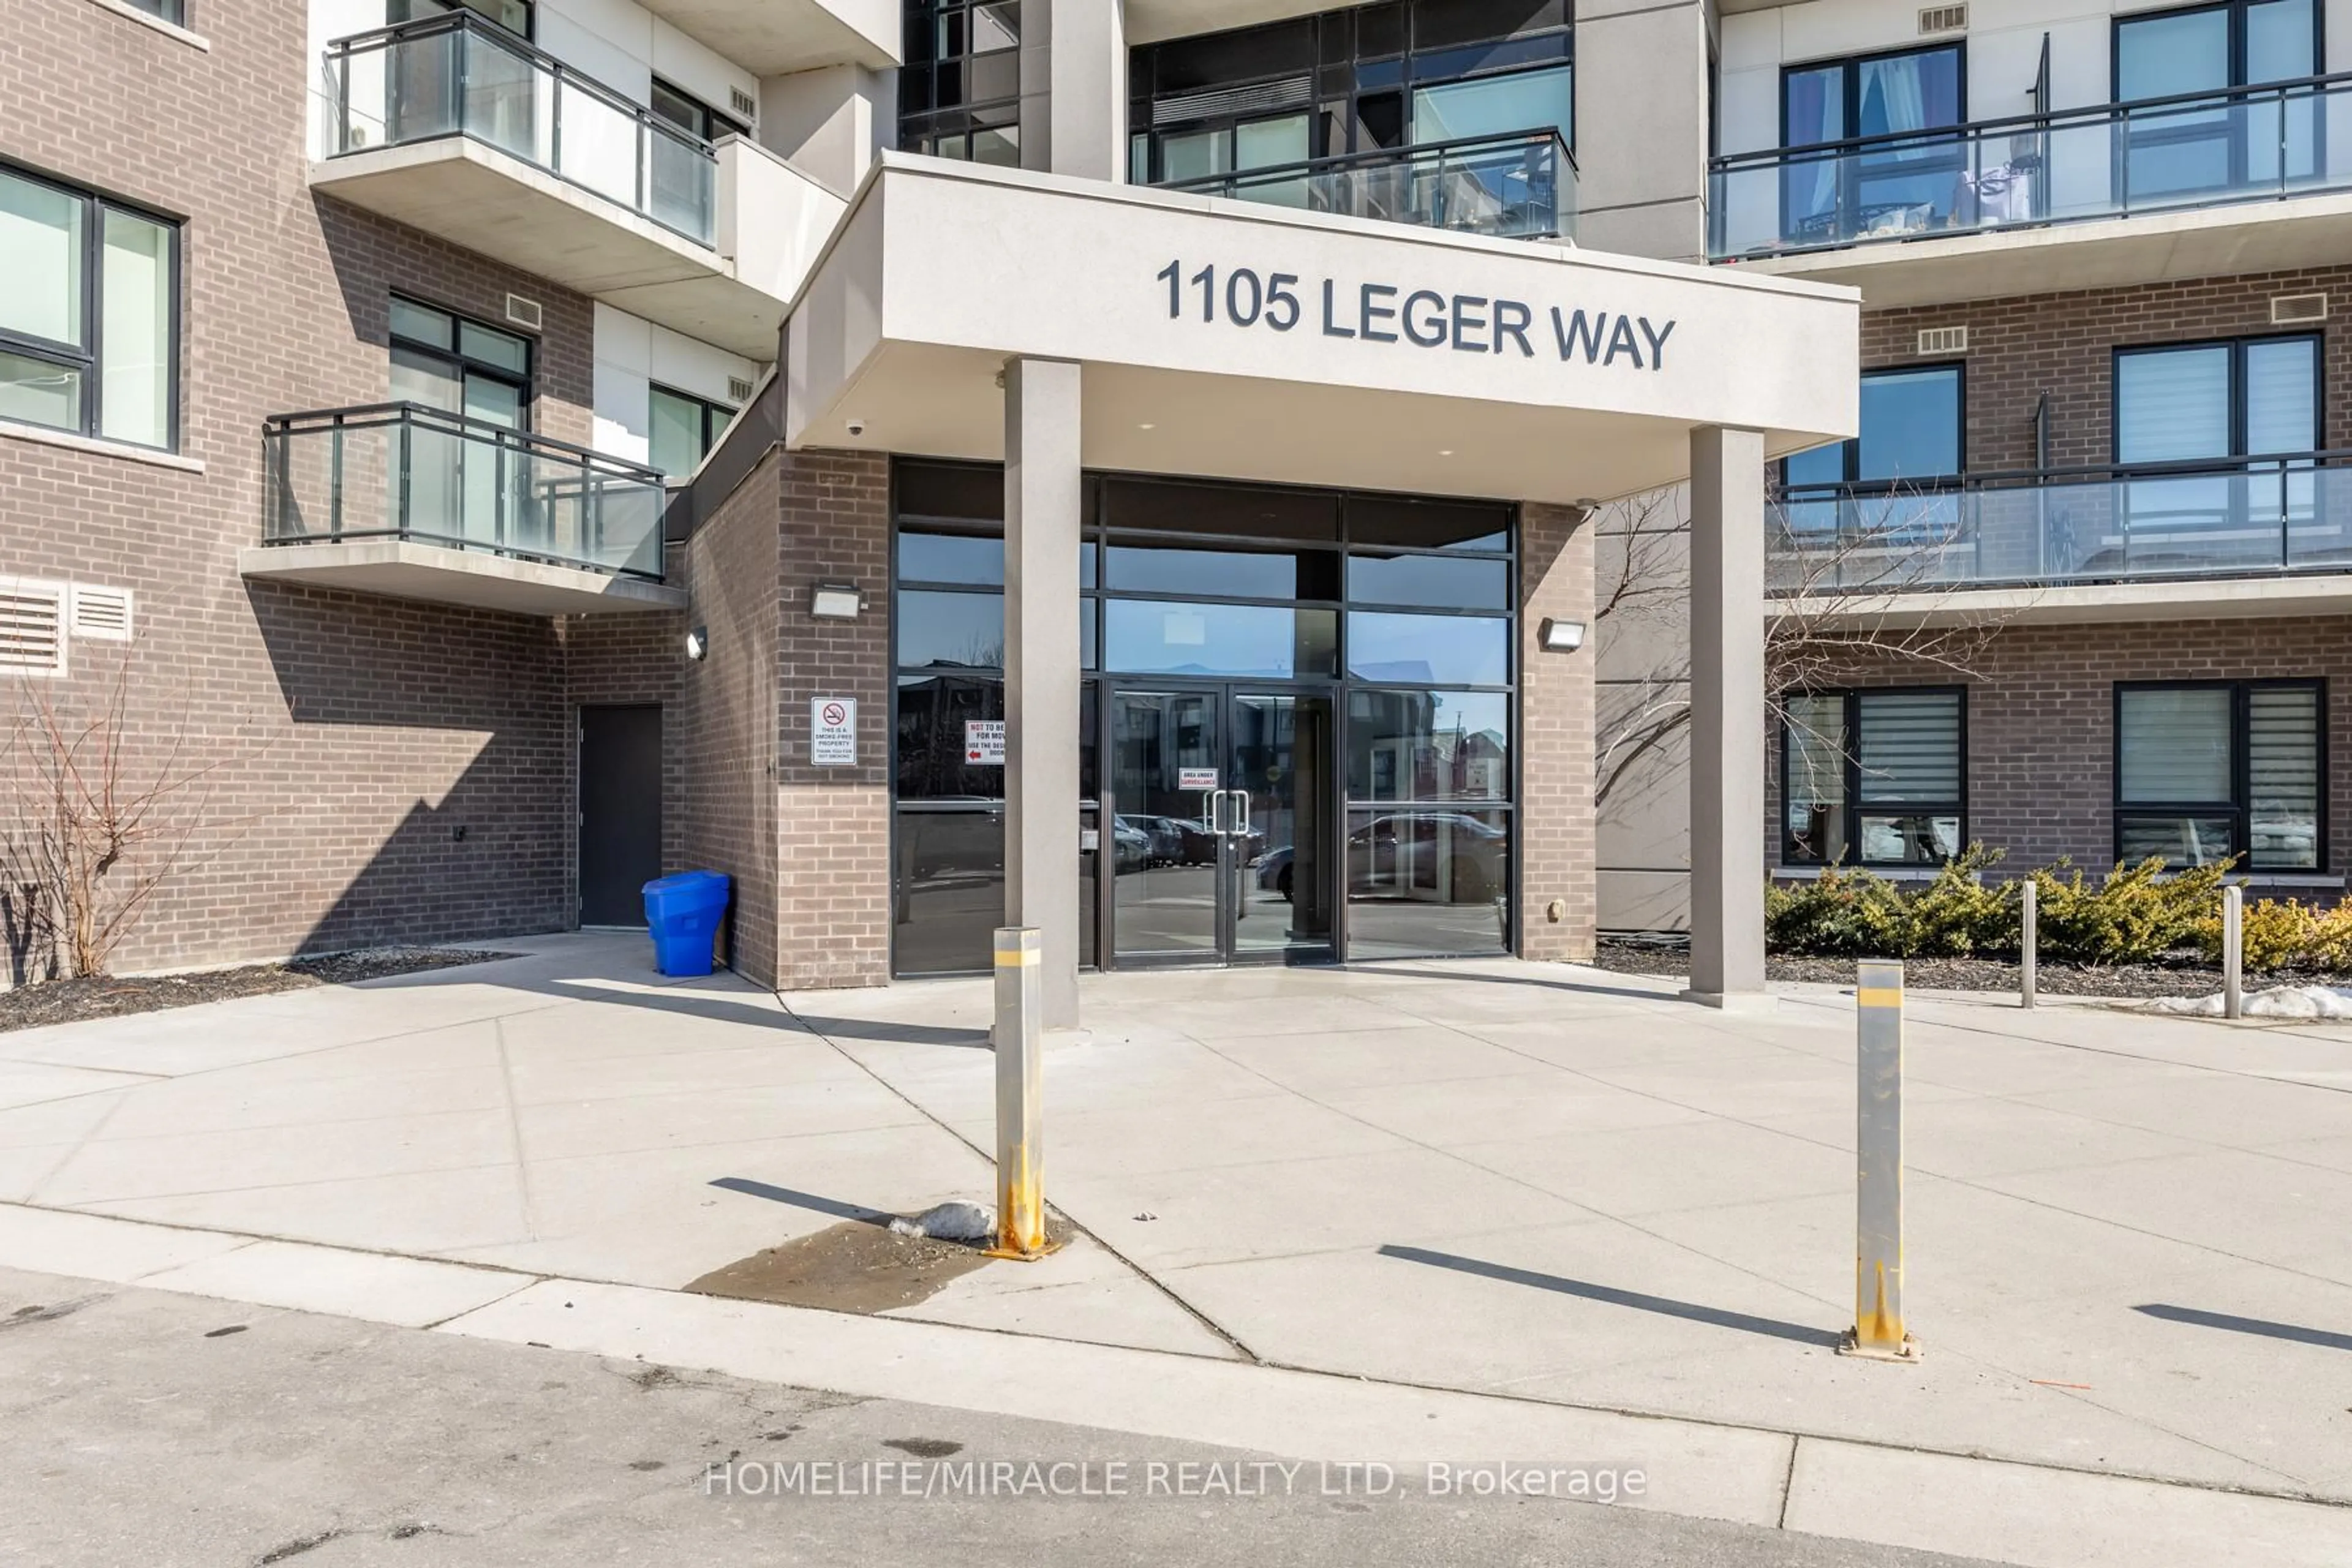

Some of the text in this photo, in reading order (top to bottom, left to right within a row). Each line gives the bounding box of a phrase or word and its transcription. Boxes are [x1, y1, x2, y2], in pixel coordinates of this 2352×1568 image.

[1158, 260, 1676, 371] 1105 LEGER WAY
